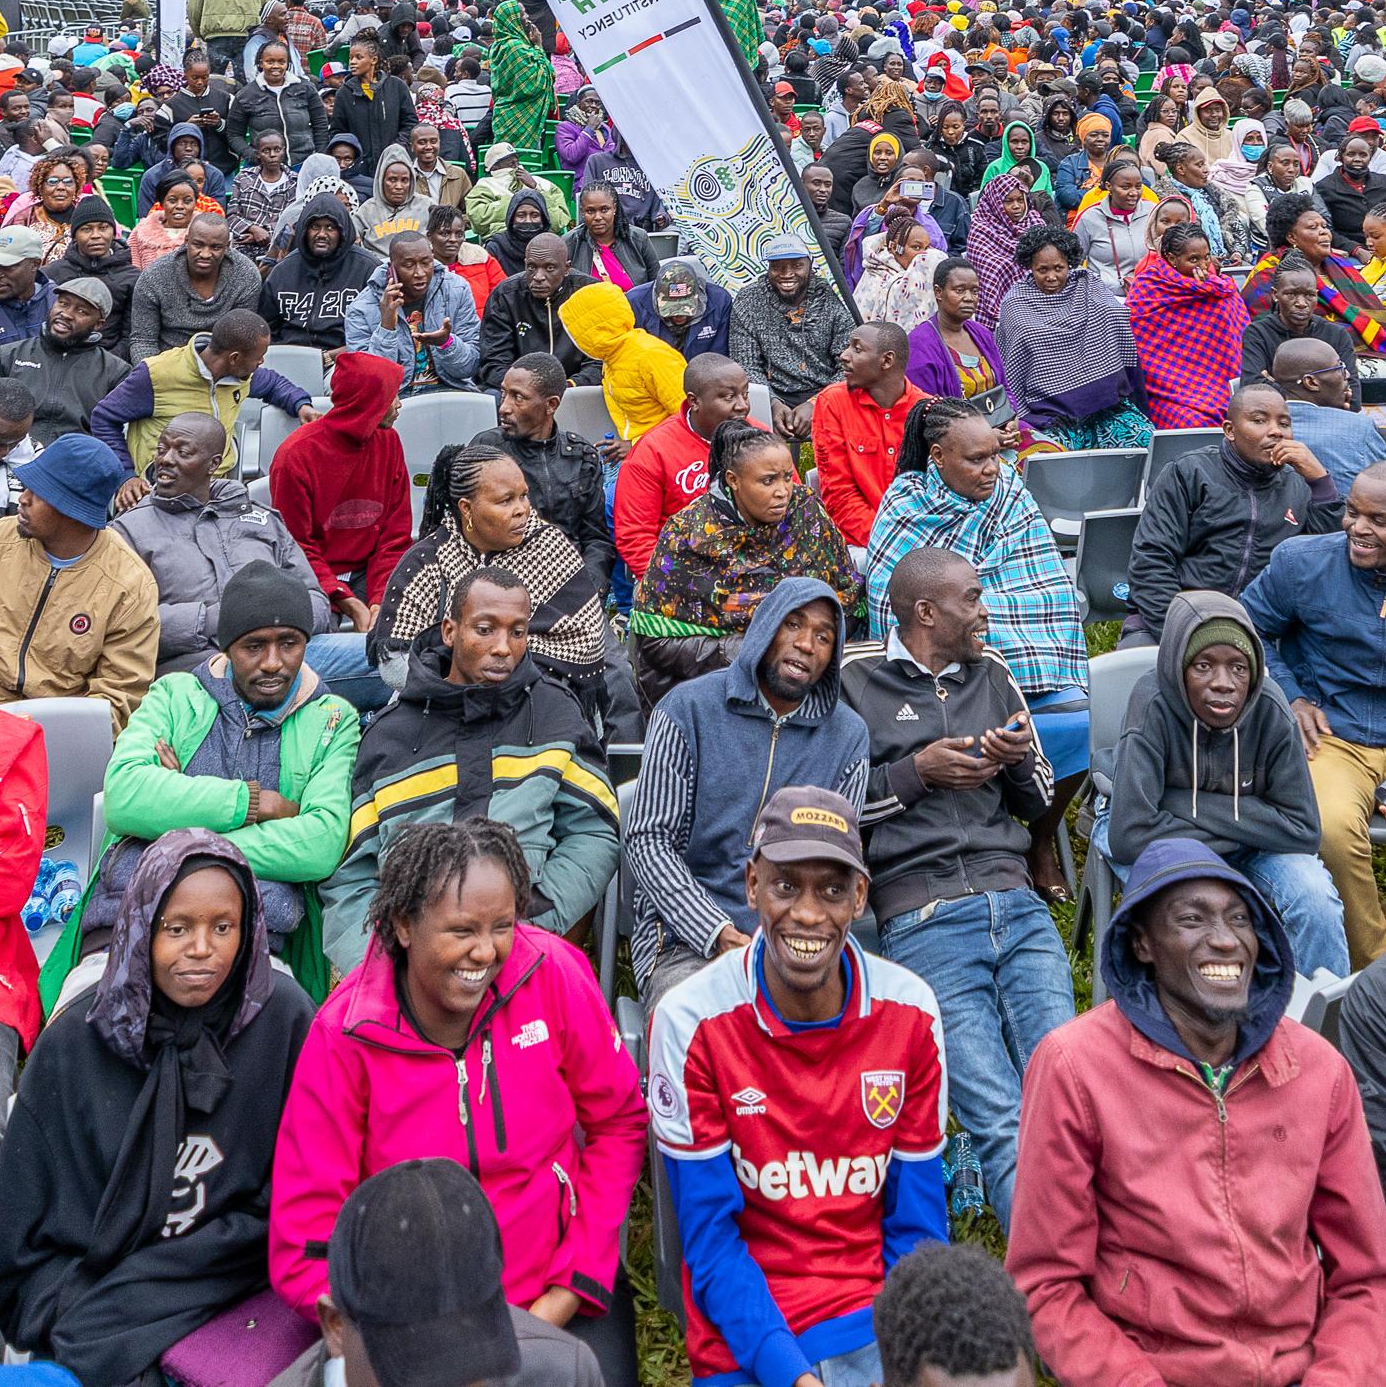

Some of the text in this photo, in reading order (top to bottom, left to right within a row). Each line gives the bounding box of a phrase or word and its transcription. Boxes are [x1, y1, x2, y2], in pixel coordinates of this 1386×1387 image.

[796, 811, 844, 829] MOZZART
[520, 1021, 538, 1033] THE
[511, 1029, 540, 1046] NORTH
[519, 1036, 545, 1050] FACE
[736, 1104, 766, 1116] umbro
[733, 1147, 894, 1201] betway
